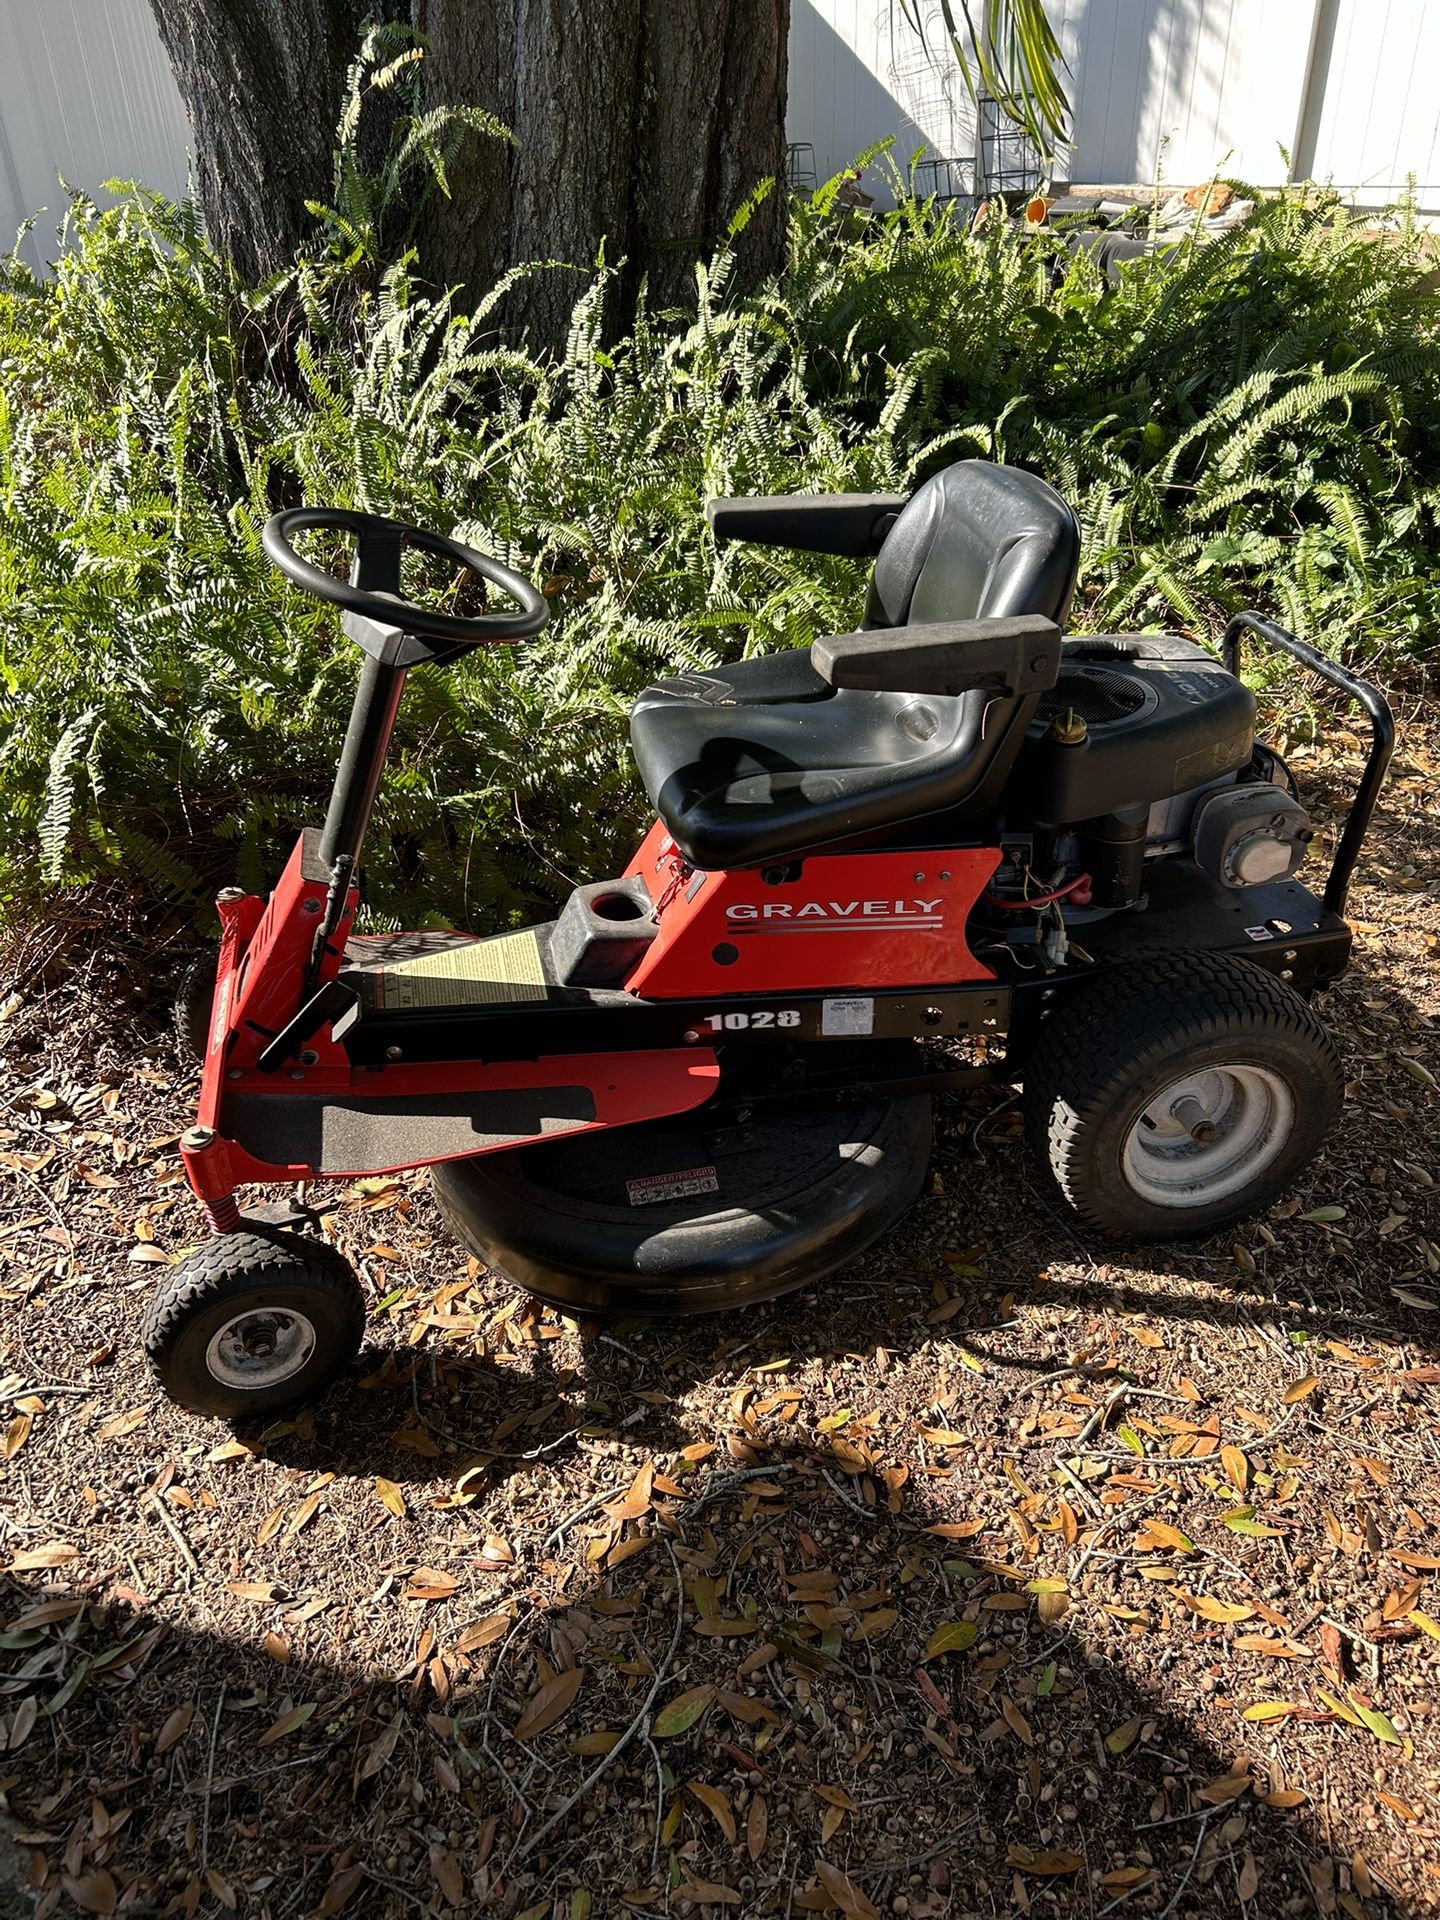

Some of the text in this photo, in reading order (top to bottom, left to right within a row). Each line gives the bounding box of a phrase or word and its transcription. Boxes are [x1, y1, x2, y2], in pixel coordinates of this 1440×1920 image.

[725, 898, 946, 919] GRAVELY
[703, 1010, 802, 1031] 1028
[641, 1167, 714, 1188] DANGER/PELIGRO
